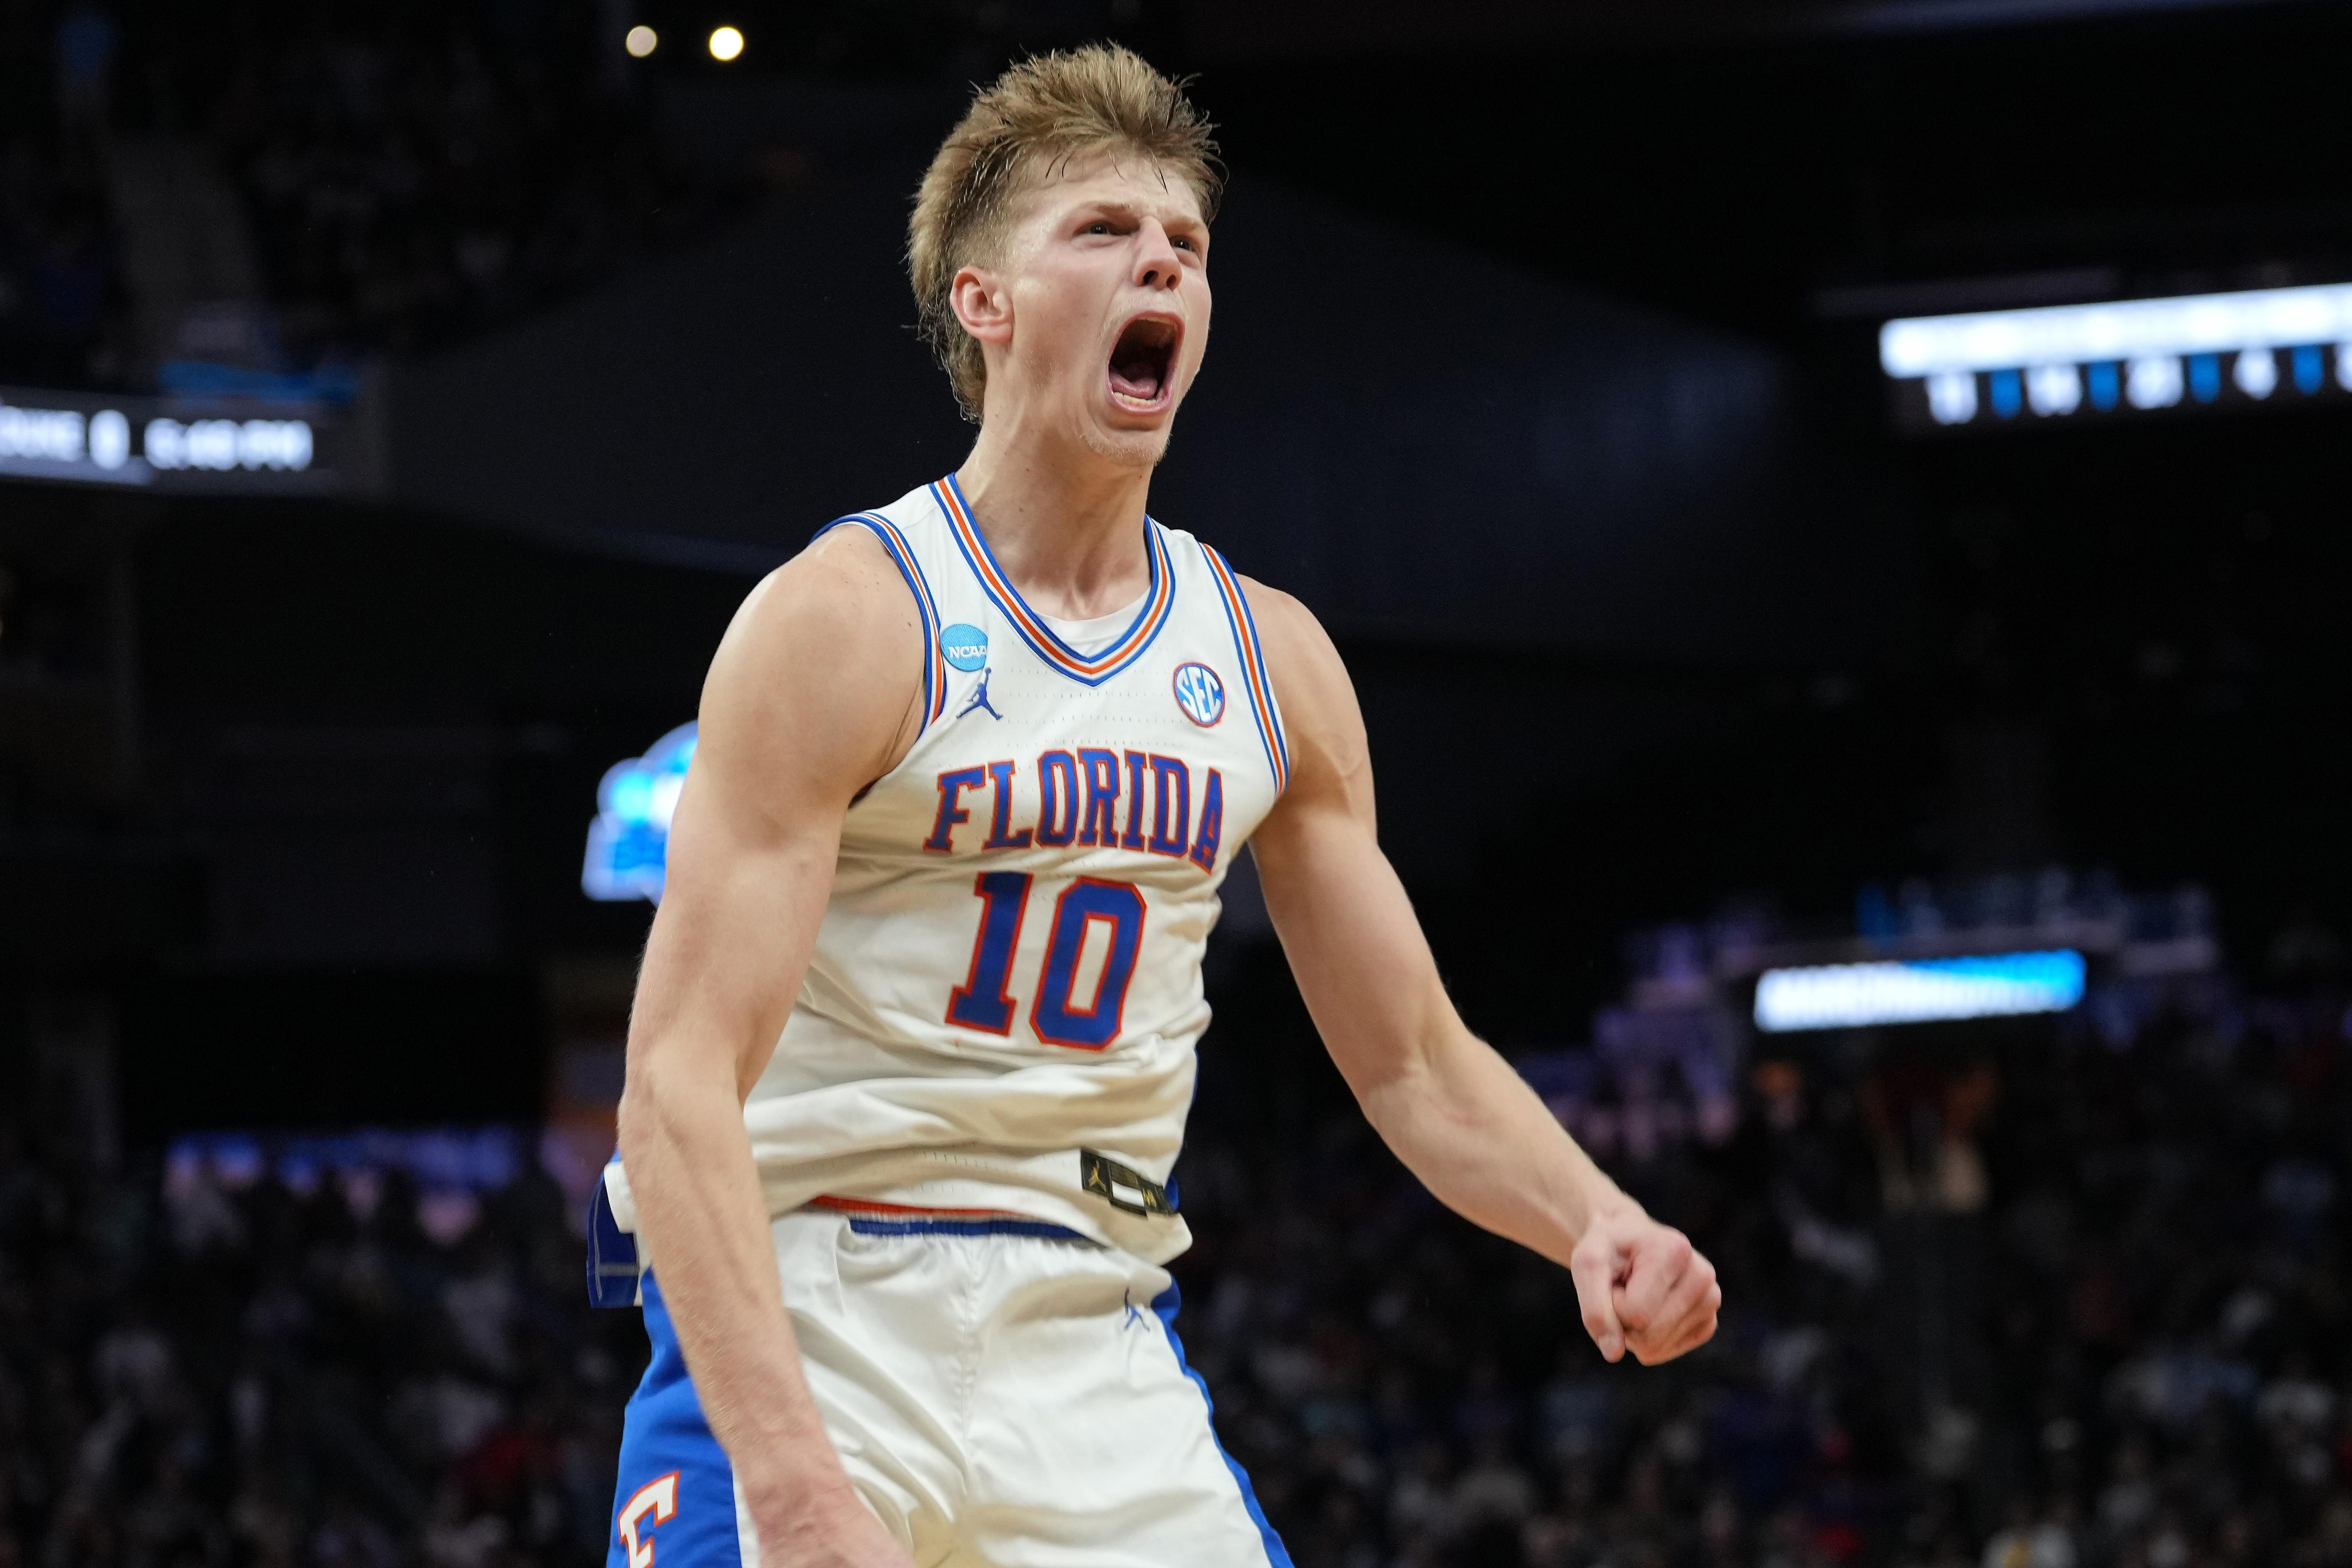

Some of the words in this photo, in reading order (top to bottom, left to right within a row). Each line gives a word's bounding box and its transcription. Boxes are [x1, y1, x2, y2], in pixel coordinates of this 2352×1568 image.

[948, 645, 987, 659] NCAA
[1176, 666, 1222, 723] SEC
[923, 747, 1224, 875] FLORIDA
[945, 871, 1147, 1051] 10
